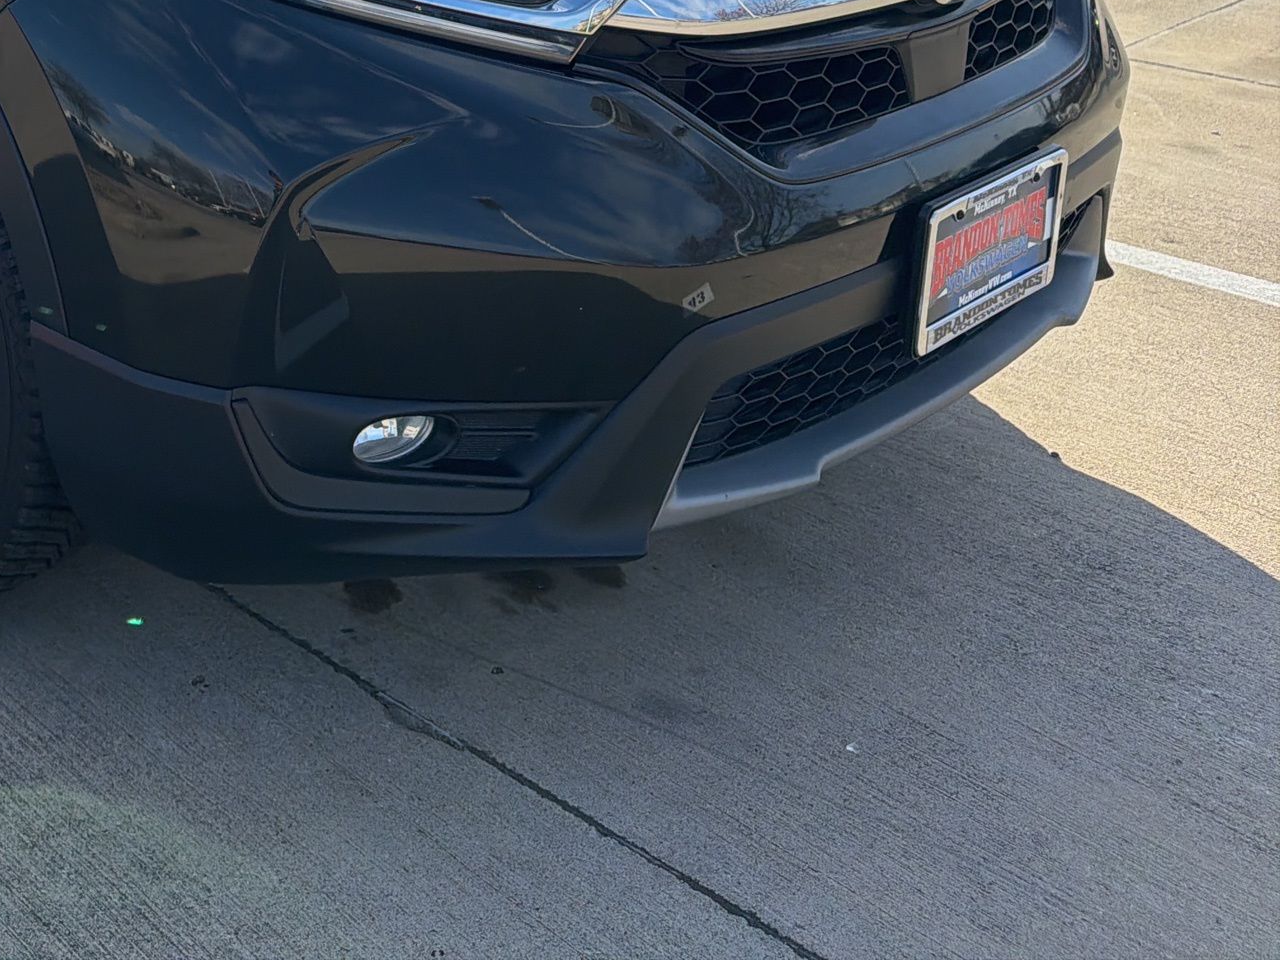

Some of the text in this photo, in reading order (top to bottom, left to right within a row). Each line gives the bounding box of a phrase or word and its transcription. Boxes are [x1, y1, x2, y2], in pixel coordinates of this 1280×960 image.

[930, 186, 1047, 299] BRANDON TOMES
[946, 233, 1029, 295] VOLKSWAGEN
[932, 270, 1043, 344] BRANDON TOMES
[952, 291, 1026, 335] VOLKSWAGEN
